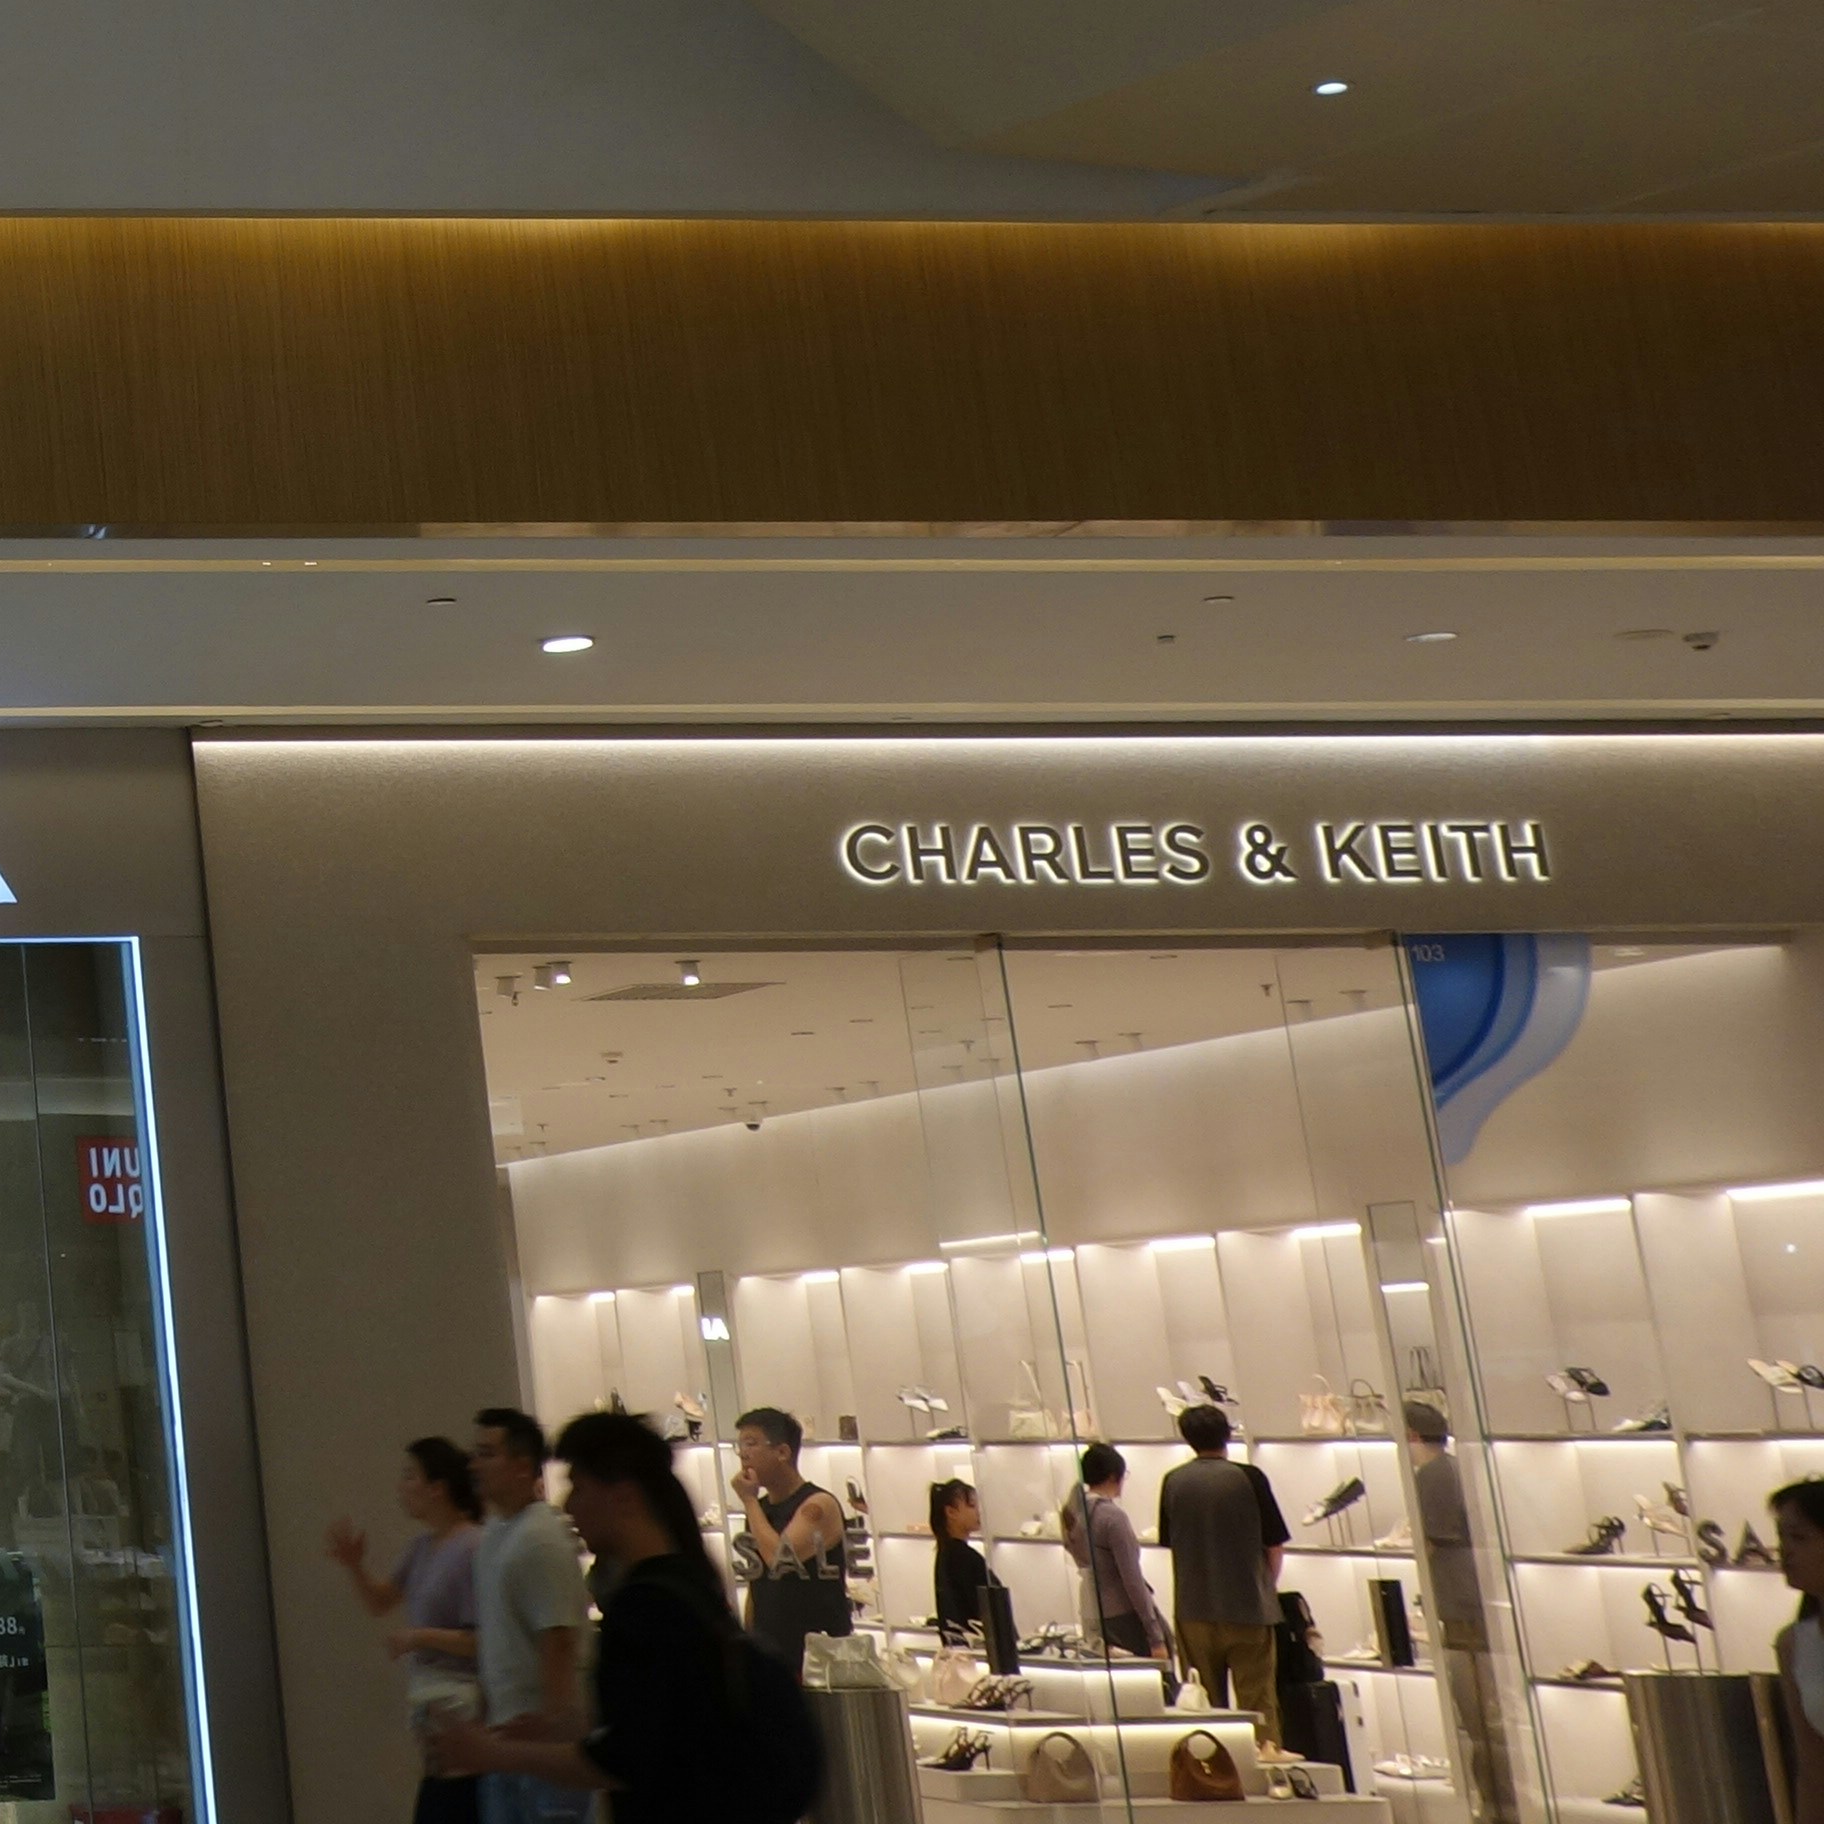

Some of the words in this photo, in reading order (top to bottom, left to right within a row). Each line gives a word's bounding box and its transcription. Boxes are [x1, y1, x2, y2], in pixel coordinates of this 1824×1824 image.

[840, 819, 1211, 885] CHARLES
[1238, 819, 1297, 883] &
[1319, 818, 1553, 884] KEITH
[1412, 944, 1445, 962] 103
[732, 1528, 875, 1581] SALE
